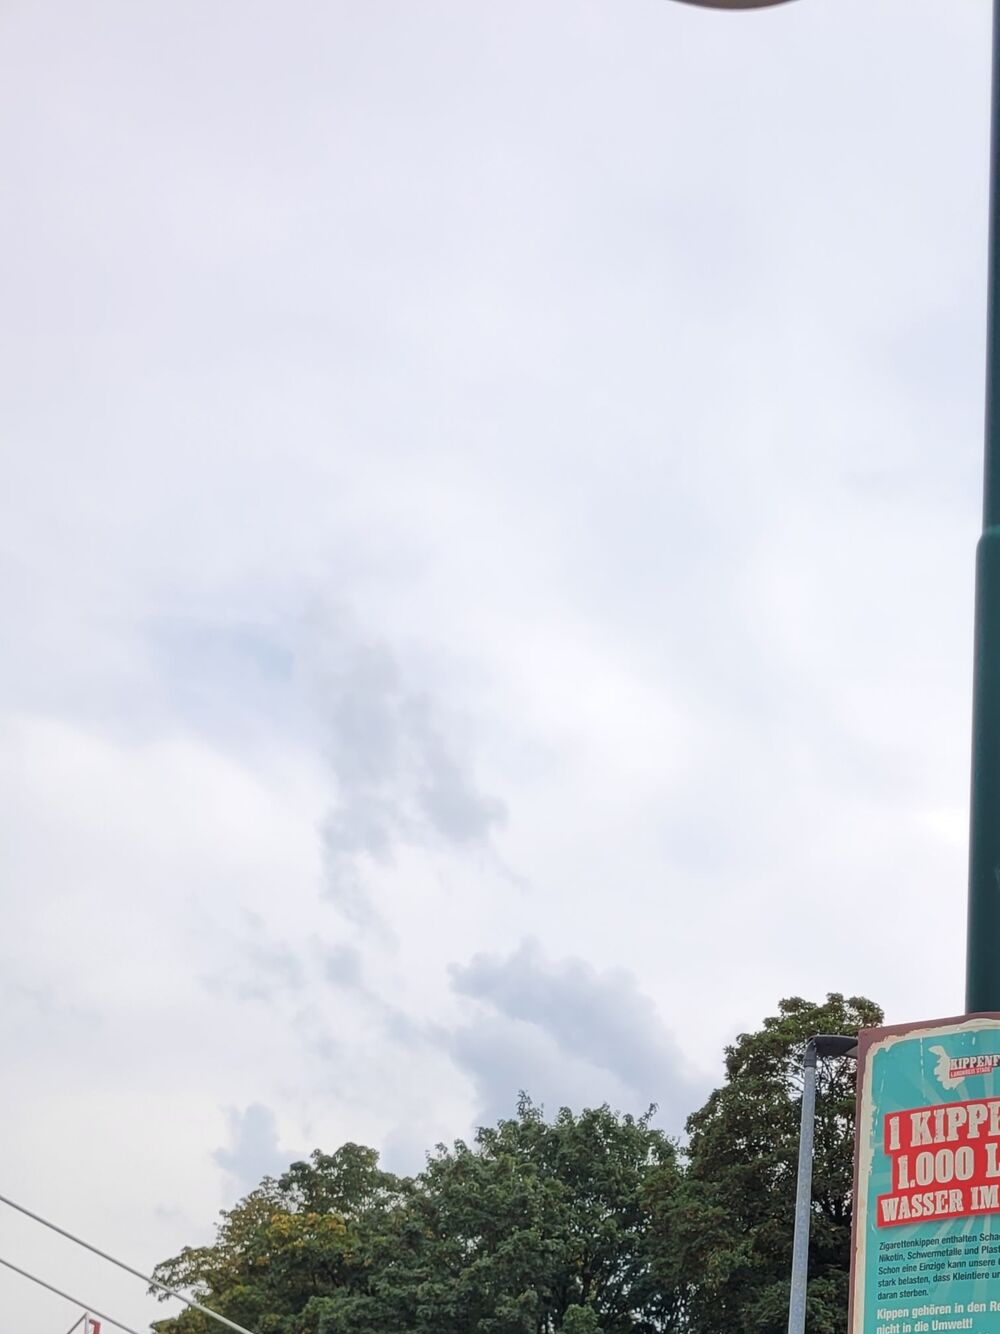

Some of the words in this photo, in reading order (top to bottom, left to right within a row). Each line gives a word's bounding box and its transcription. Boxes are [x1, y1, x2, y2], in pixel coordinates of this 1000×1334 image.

[889, 1116, 900, 1150] 1
[898, 1146, 974, 1190] 1.000
[881, 1189, 964, 1222] WASSER
[970, 1184, 1000, 1210] IM
[880, 1238, 940, 1251] Zigarettenkippen
[942, 1234, 977, 1244] enthalten
[878, 1253, 905, 1262] Nikotin,
[907, 1248, 962, 1260] Schwermetalle
[964, 1246, 979, 1255] und
[878, 1266, 900, 1275] Schon
[902, 1264, 917, 1272] eine
[919, 1262, 945, 1271] Einzige
[969, 1259, 996, 1267] unsere
[878, 1278, 896, 1287] stark
[898, 1276, 930, 1285] belasten,
[932, 1274, 950, 1282] dass
[952, 1271, 989, 1280] Kleintiere
[878, 1292, 897, 1300] daran
[900, 1289, 929, 1298] sterben.
[877, 1308, 909, 1320] Kippen
[912, 1304, 951, 1318] gehören
[954, 1302, 964, 1313] in
[967, 1301, 986, 1313] den
[903, 1322, 911, 1333] in
[914, 1321, 929, 1332] die
[932, 1318, 973, 1330] Umwelt!
